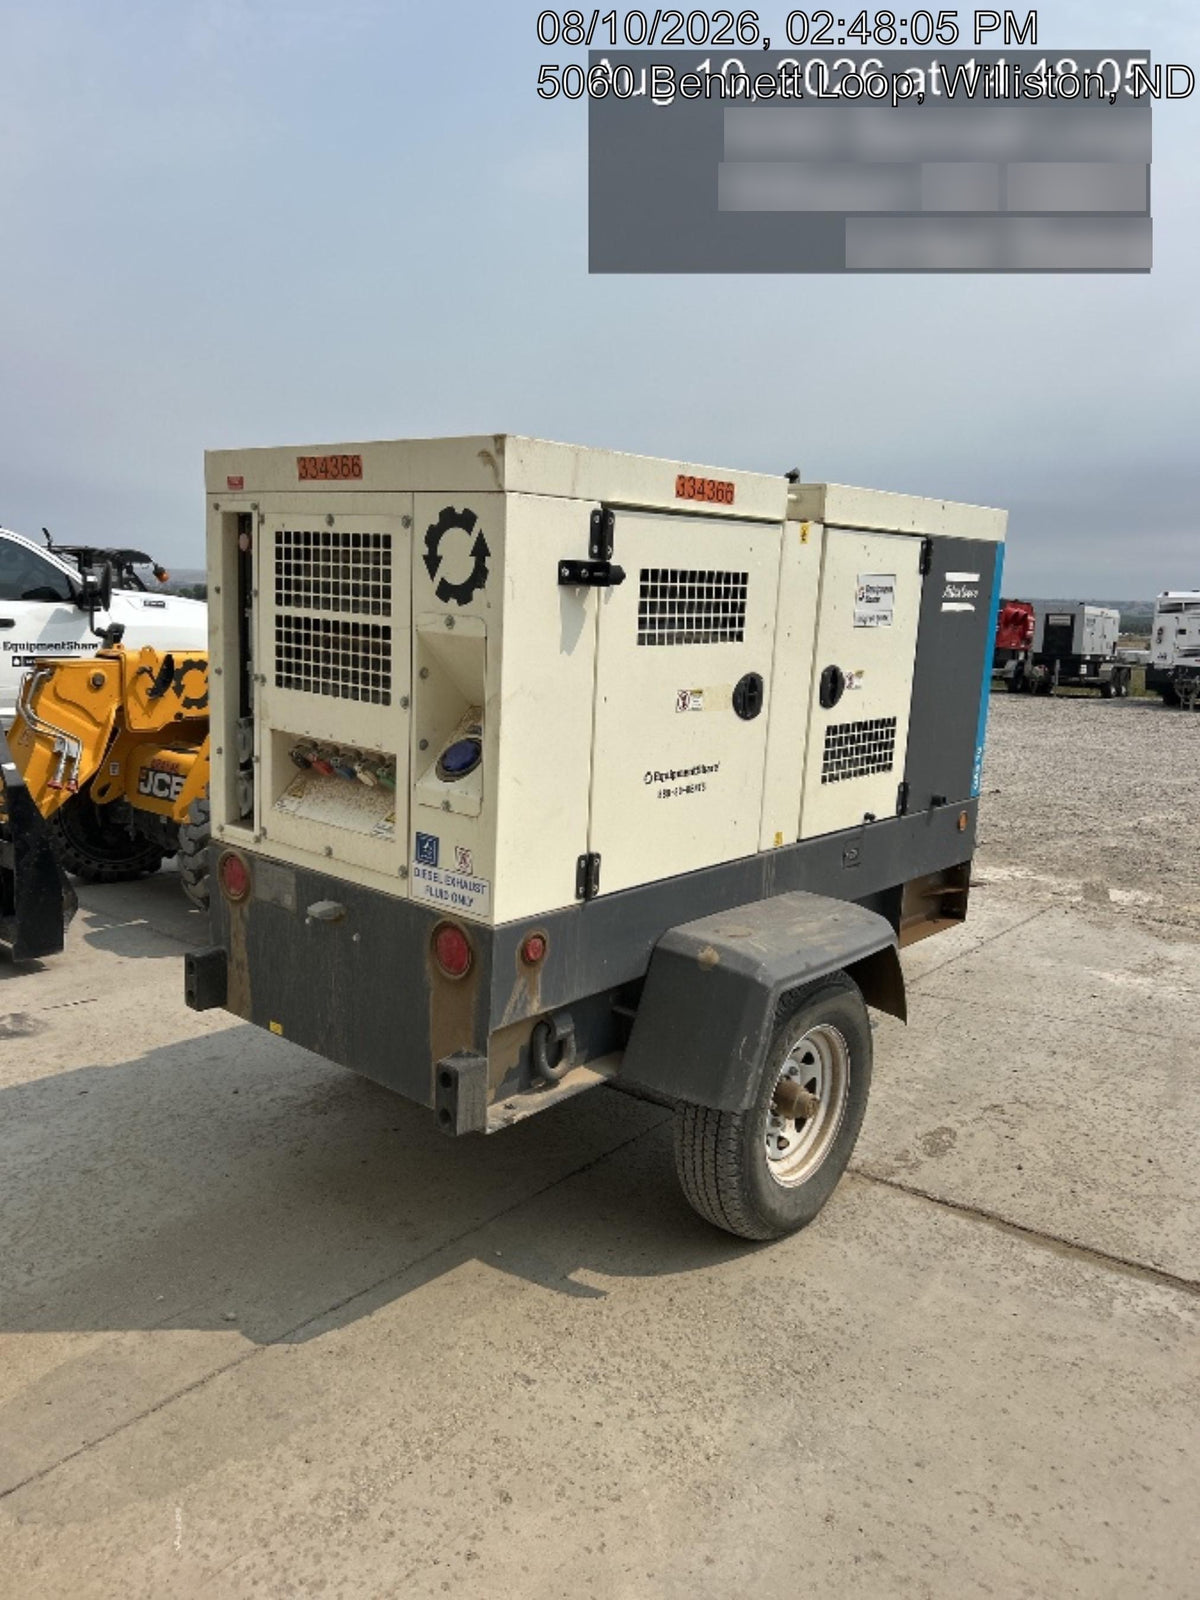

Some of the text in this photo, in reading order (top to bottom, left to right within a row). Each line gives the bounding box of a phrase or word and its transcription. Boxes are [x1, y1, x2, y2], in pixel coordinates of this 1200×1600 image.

[299, 455, 362, 479] 334366
[676, 474, 735, 505] 334366
[2, 641, 99, 653] EquipmentShare
[445, 874, 487, 895] EXHAUST
[426, 885, 474, 907] FLUID ONLY
